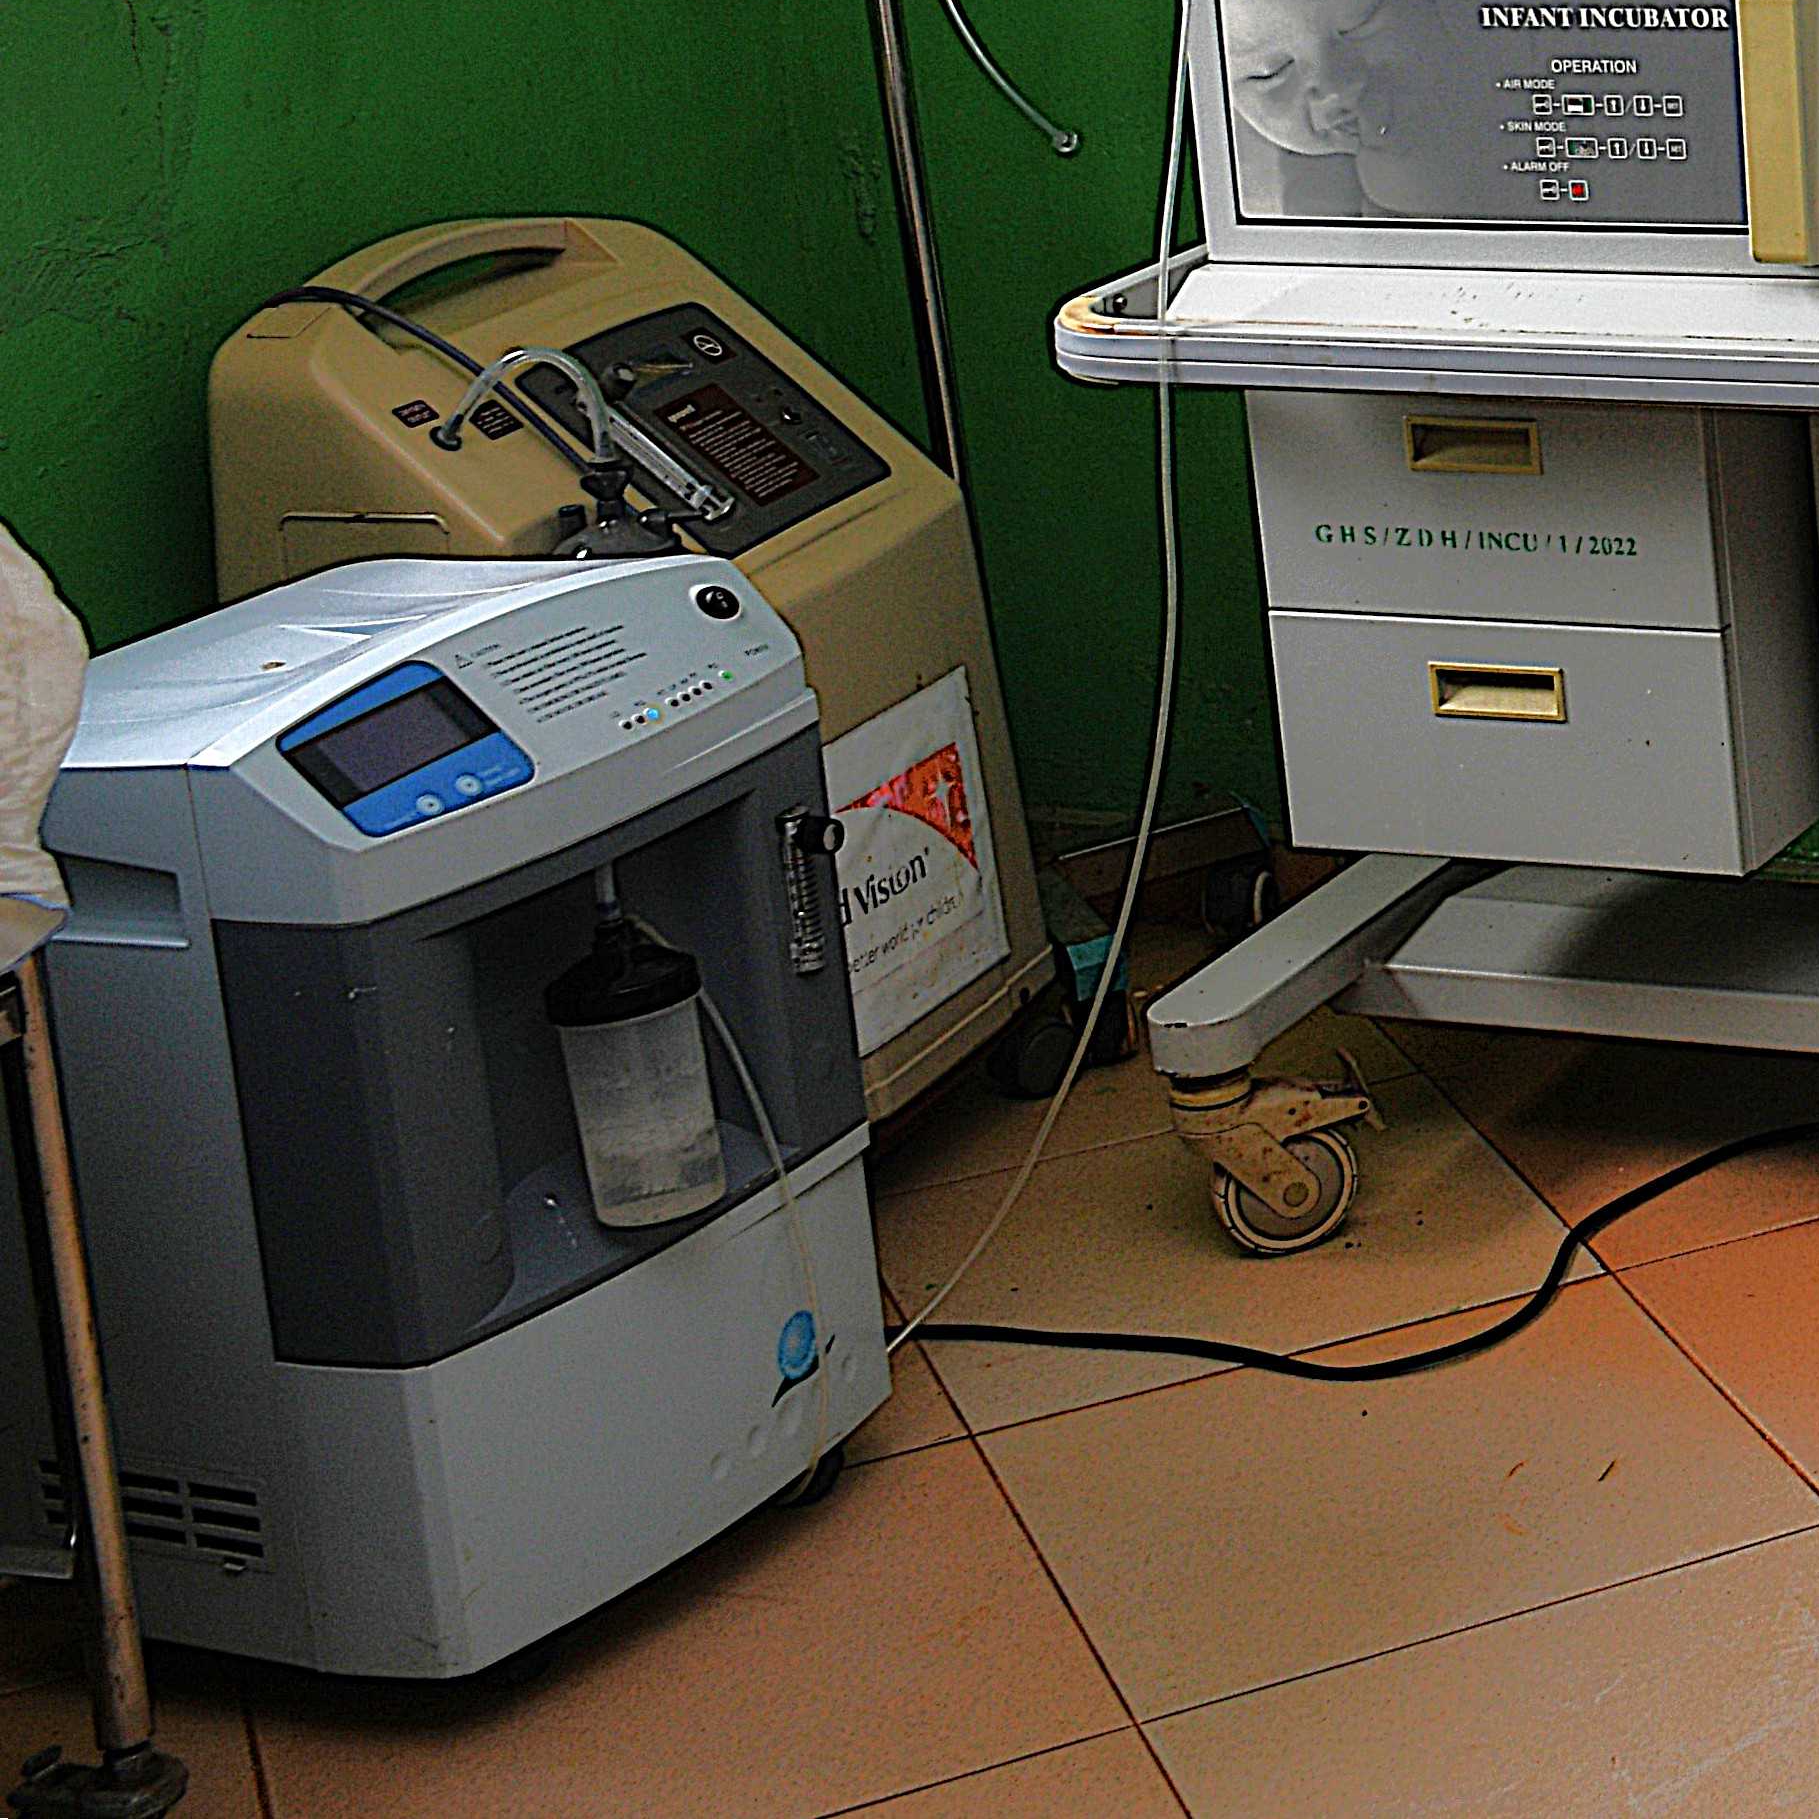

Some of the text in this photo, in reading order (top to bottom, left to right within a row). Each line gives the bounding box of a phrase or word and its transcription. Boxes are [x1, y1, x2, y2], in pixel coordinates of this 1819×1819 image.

[1479, 7, 1729, 28] INFANT INCUBATOR
[1550, 59, 1637, 73] OPERATION
[1503, 79, 1555, 90] AIR MODE
[1506, 121, 1567, 132] SKIN MODE
[1510, 161, 1569, 172] ALARM OFF
[853, 854, 927, 915] Vision
